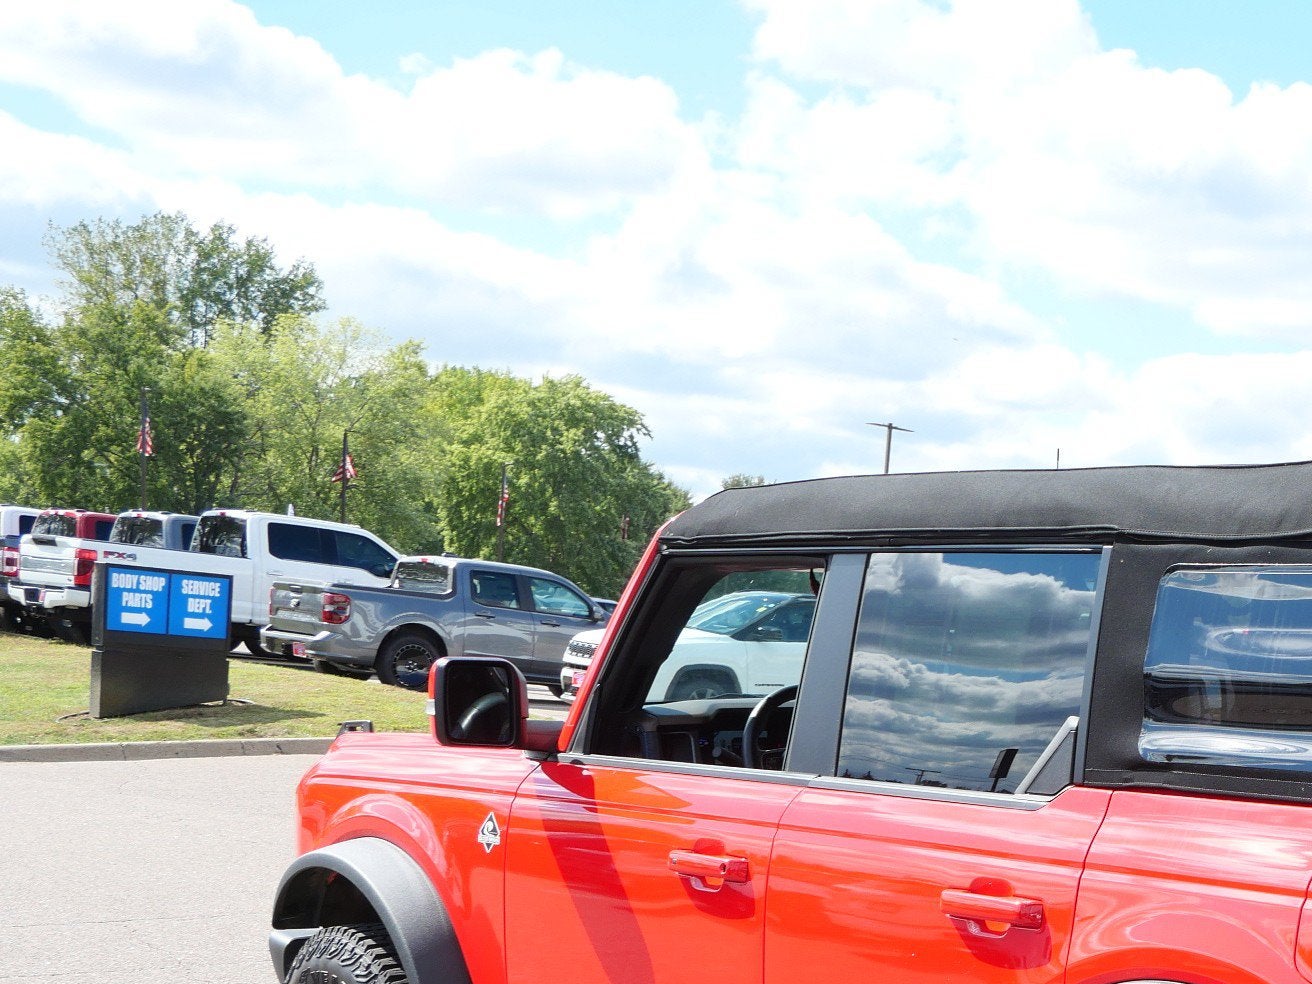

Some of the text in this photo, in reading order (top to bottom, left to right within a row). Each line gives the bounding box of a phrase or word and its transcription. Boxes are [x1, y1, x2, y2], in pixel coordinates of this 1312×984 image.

[103, 550, 137, 561] FX4
[111, 572, 166, 592] BODY SHOP
[181, 579, 221, 597] SERVICE
[121, 591, 153, 609] PARTS
[187, 597, 213, 614] DEPT.
